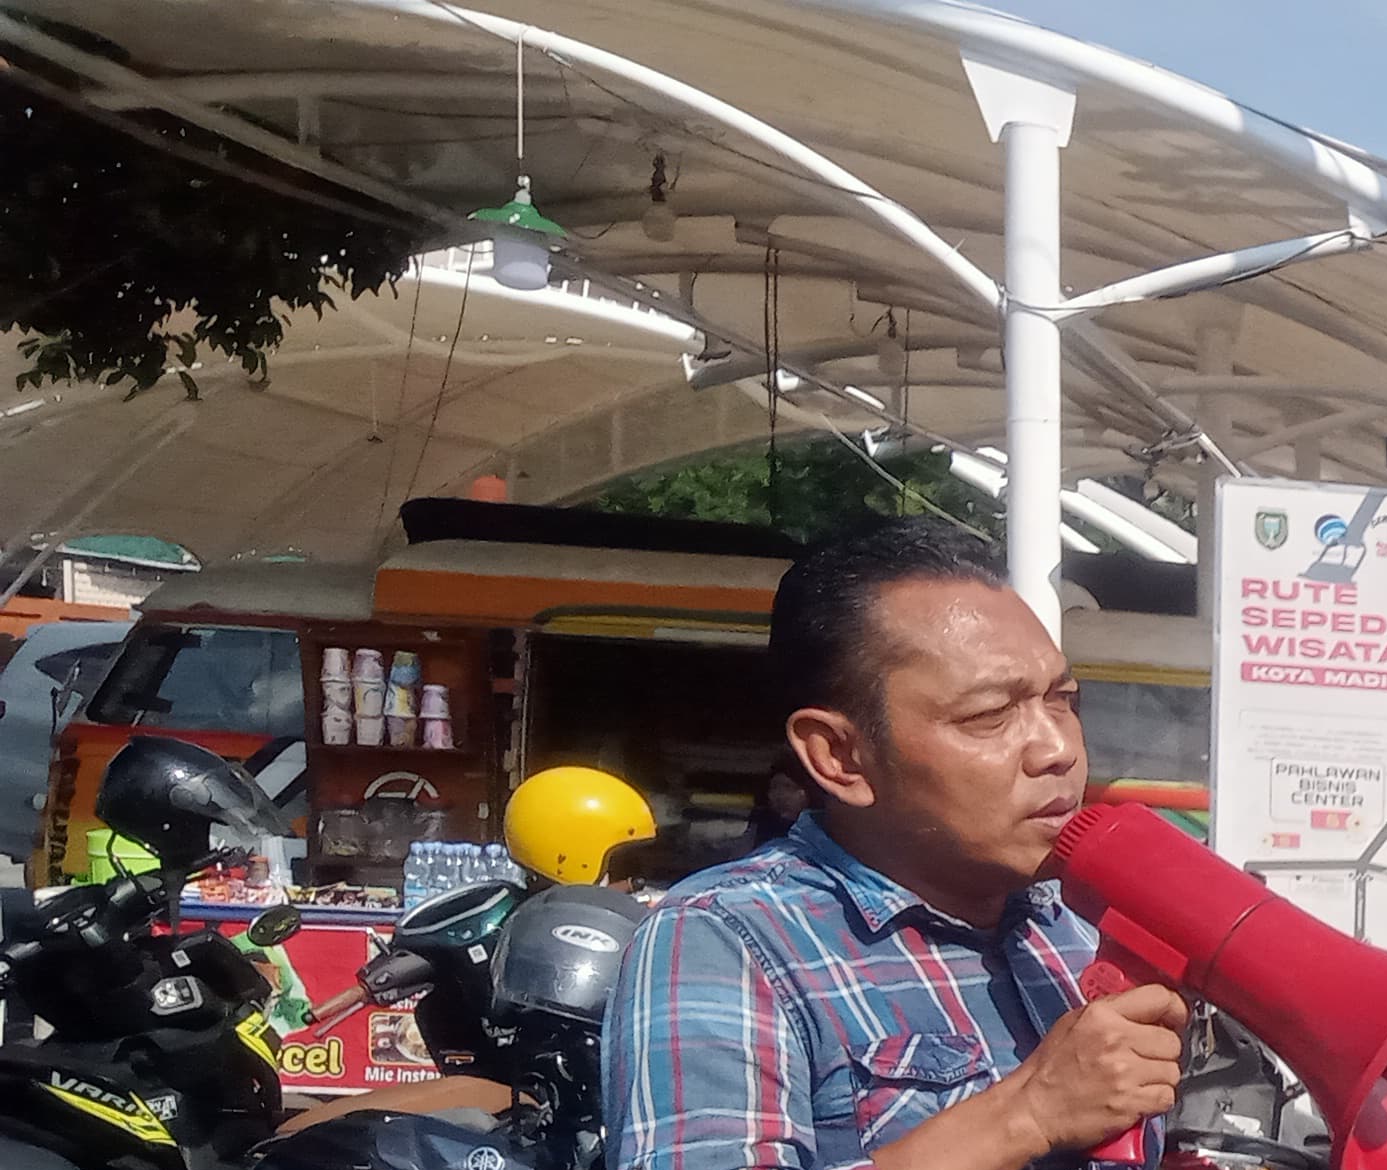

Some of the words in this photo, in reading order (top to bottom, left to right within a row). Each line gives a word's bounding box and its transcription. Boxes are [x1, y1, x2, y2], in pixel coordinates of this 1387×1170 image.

[1241, 578, 1358, 605] RUTE
[1251, 666, 1314, 685] KOTA
[1275, 763, 1381, 782] PAHLAWAN
[1299, 779, 1356, 795] BISNIS
[1291, 792, 1364, 808] CENTER
[561, 928, 609, 946] INK
[277, 1039, 342, 1075] cel
[365, 1067, 394, 1082] Mie
